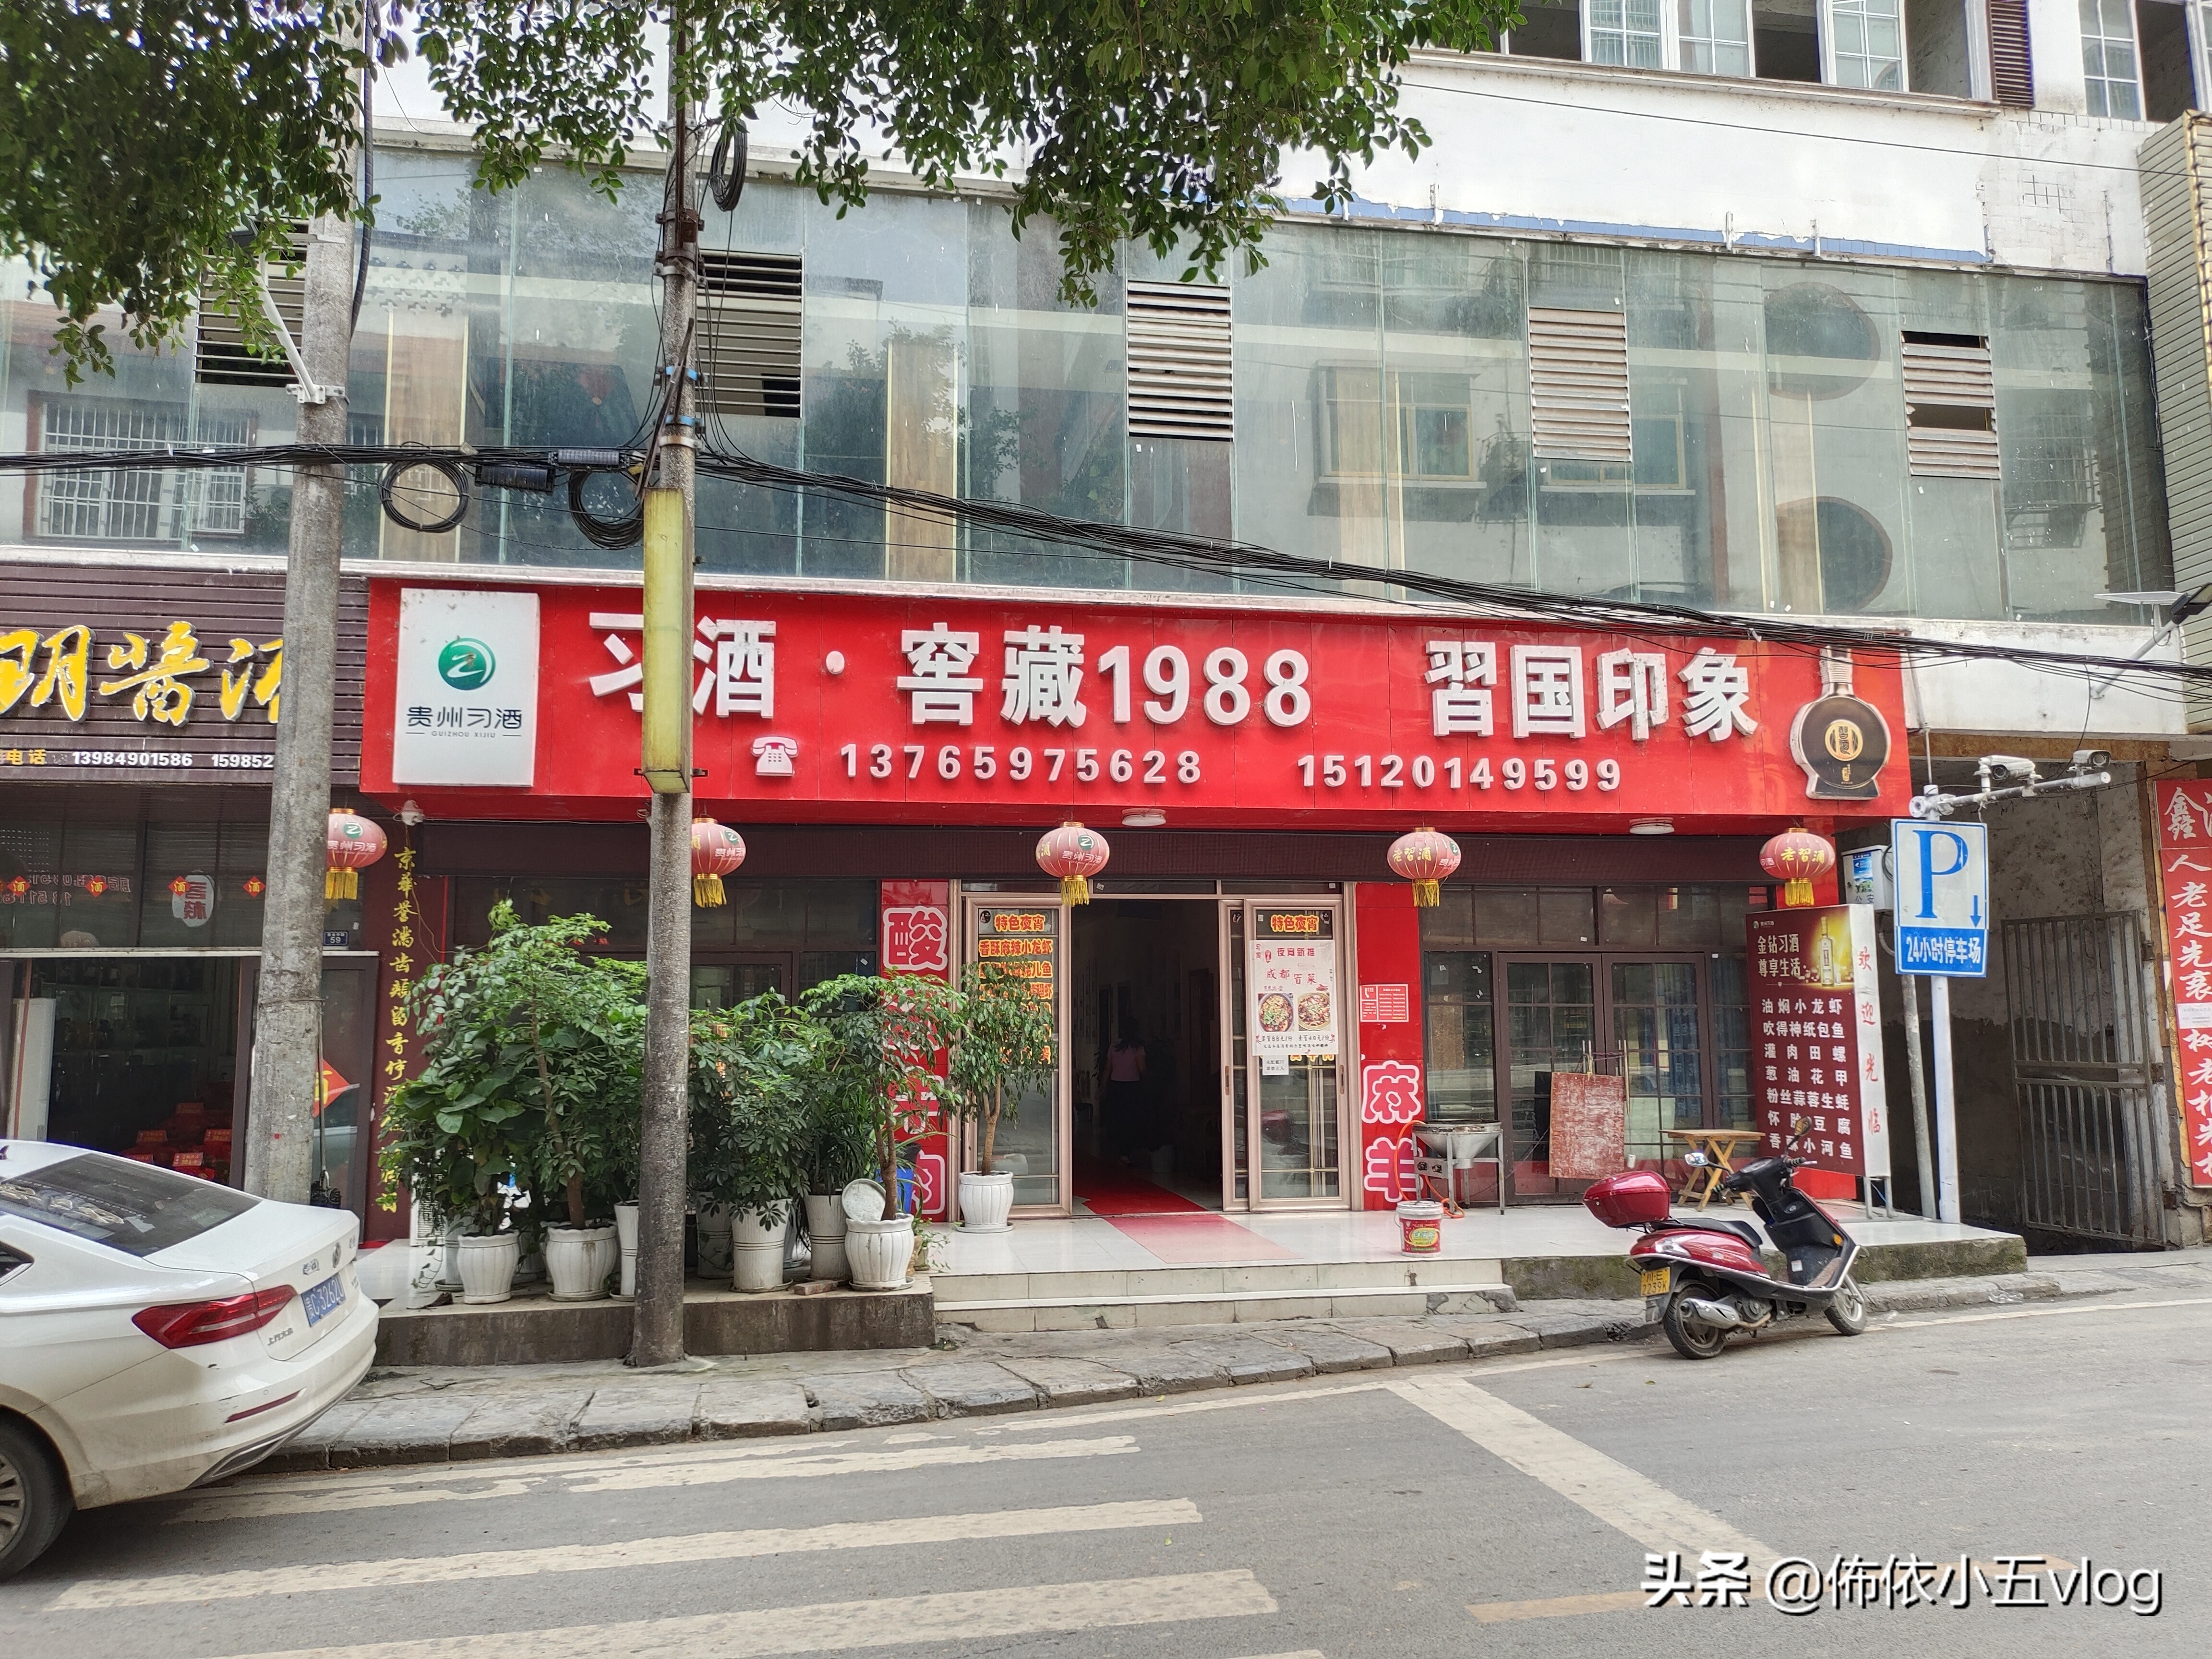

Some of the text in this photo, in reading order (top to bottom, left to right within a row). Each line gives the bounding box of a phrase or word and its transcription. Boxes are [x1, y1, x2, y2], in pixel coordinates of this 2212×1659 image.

[407, 706, 522, 729] 贵州习酒
[72, 751, 193, 767] 13984901586
[841, 743, 1621, 792] 13765975628 15120149599
[1062, 851, 1103, 864] 贵州习酒
[1912, 830, 1968, 919] P
[995, 914, 1046, 932] 特色夜宵
[1271, 914, 1319, 932] 特色夜宵
[979, 938, 1053, 958] 香酥麻辣小龙虾
[1757, 934, 1800, 954] 金钻习酒
[1906, 936, 1982, 964] 24小时停车场
[1267, 968, 1317, 985] 成都冒菜
[1758, 957, 1802, 977] 尊享生活
[1762, 998, 1843, 1015] 油焖小龙虾
[1764, 1043, 1847, 1062] 灌肉田螺
[1765, 1065, 1848, 1087] 葱油花甲
[1642, 1280, 1667, 1295] 2239K
